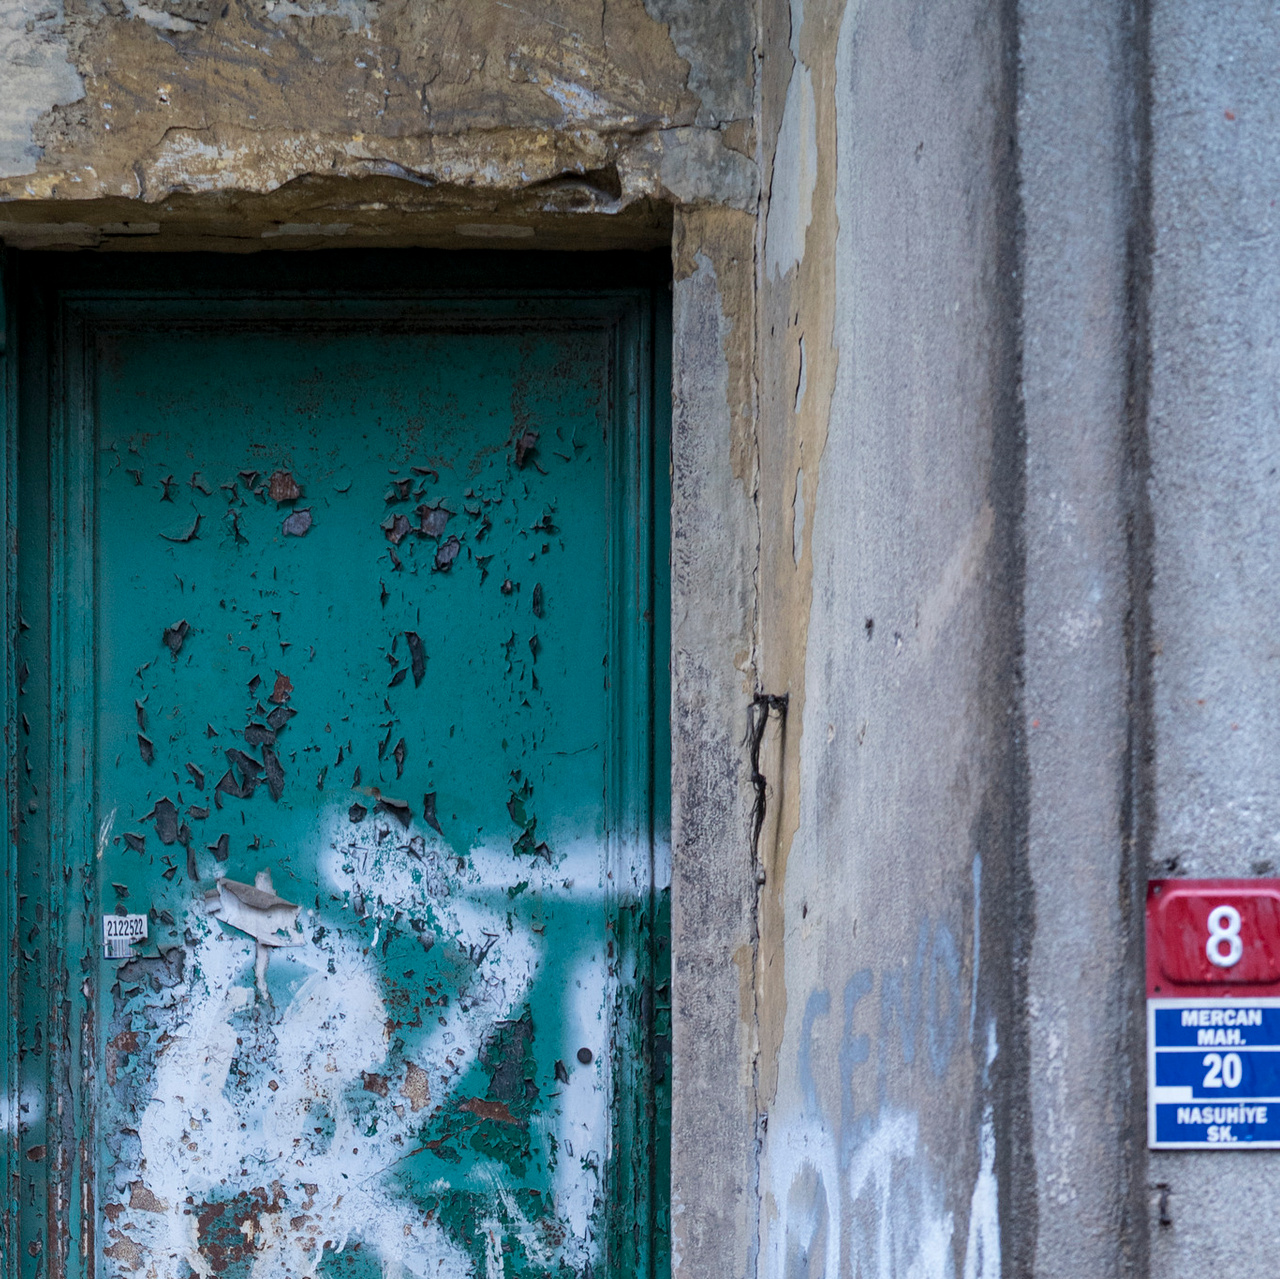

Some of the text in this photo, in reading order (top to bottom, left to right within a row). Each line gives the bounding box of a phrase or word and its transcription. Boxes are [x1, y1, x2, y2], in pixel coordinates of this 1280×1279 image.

[107, 918, 144, 937] 2122522
[1205, 905, 1244, 968] 8
[1181, 1009, 1263, 1027] MERCAN
[1196, 1028, 1247, 1046] MAH.
[1202, 1053, 1243, 1088] 20
[1176, 1102, 1269, 1125] NASUHİYE
[1206, 1126, 1239, 1143] SK.
